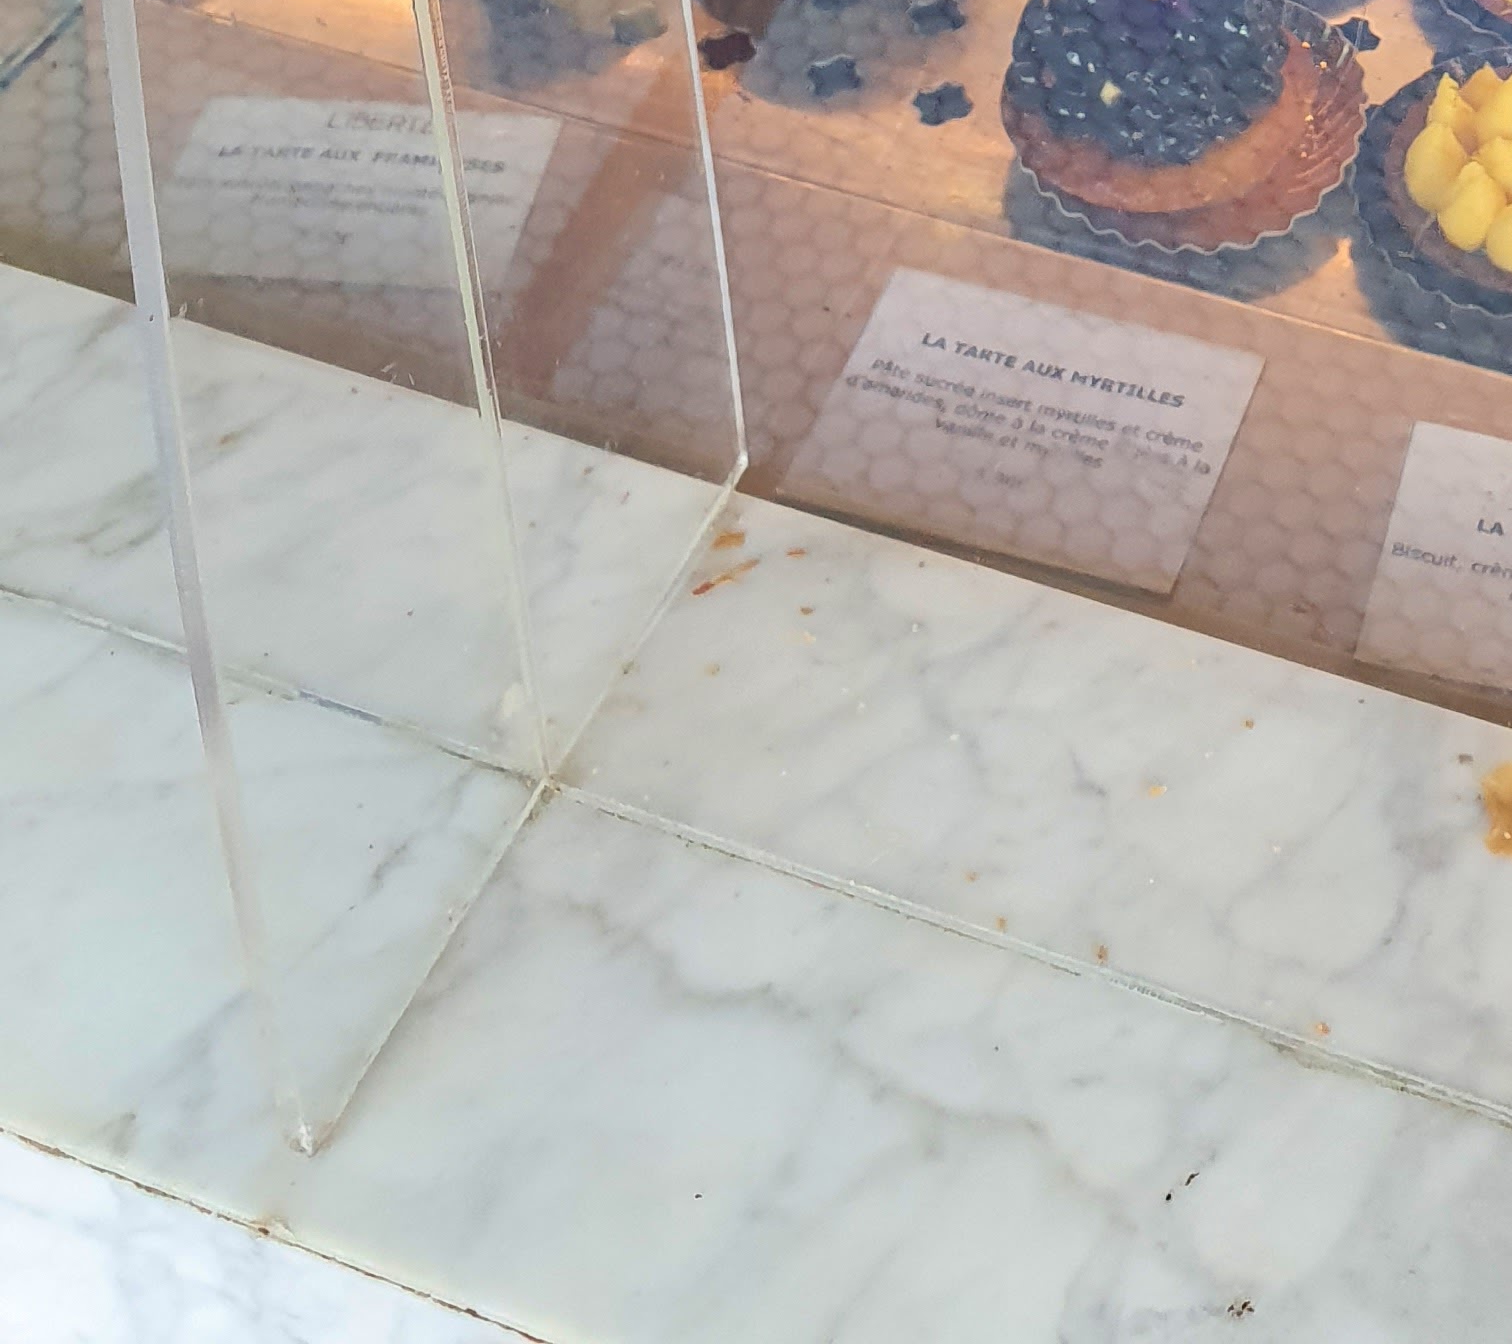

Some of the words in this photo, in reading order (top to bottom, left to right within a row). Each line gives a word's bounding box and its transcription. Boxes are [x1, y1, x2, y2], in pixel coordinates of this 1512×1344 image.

[921, 332, 947, 350] LA
[954, 340, 1018, 369] TARTE
[1022, 359, 1067, 381] AUX
[1070, 370, 1186, 408] MYRTILLES
[1476, 518, 1505, 537] LA
